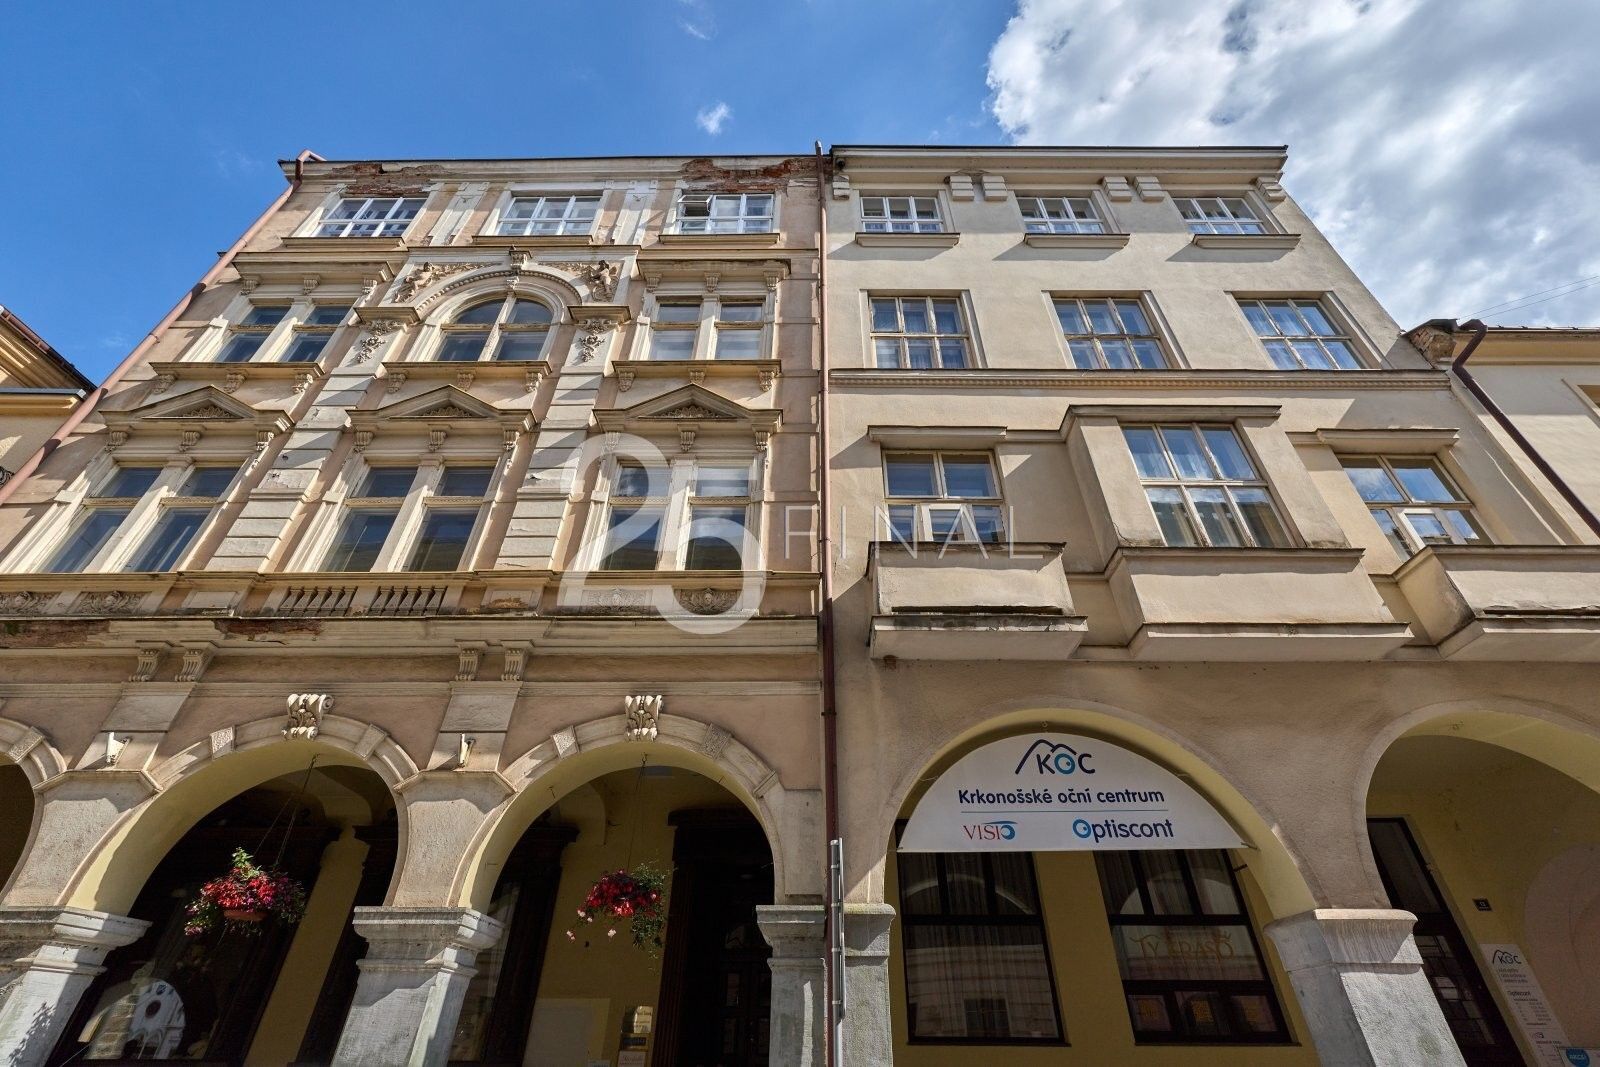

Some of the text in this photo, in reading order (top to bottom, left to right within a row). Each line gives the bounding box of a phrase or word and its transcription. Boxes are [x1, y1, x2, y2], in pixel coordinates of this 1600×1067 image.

[1036, 752, 1096, 775] KOC
[958, 788, 1165, 805] Krkonošské oční centrum
[1072, 818, 1175, 844] Optiscont
